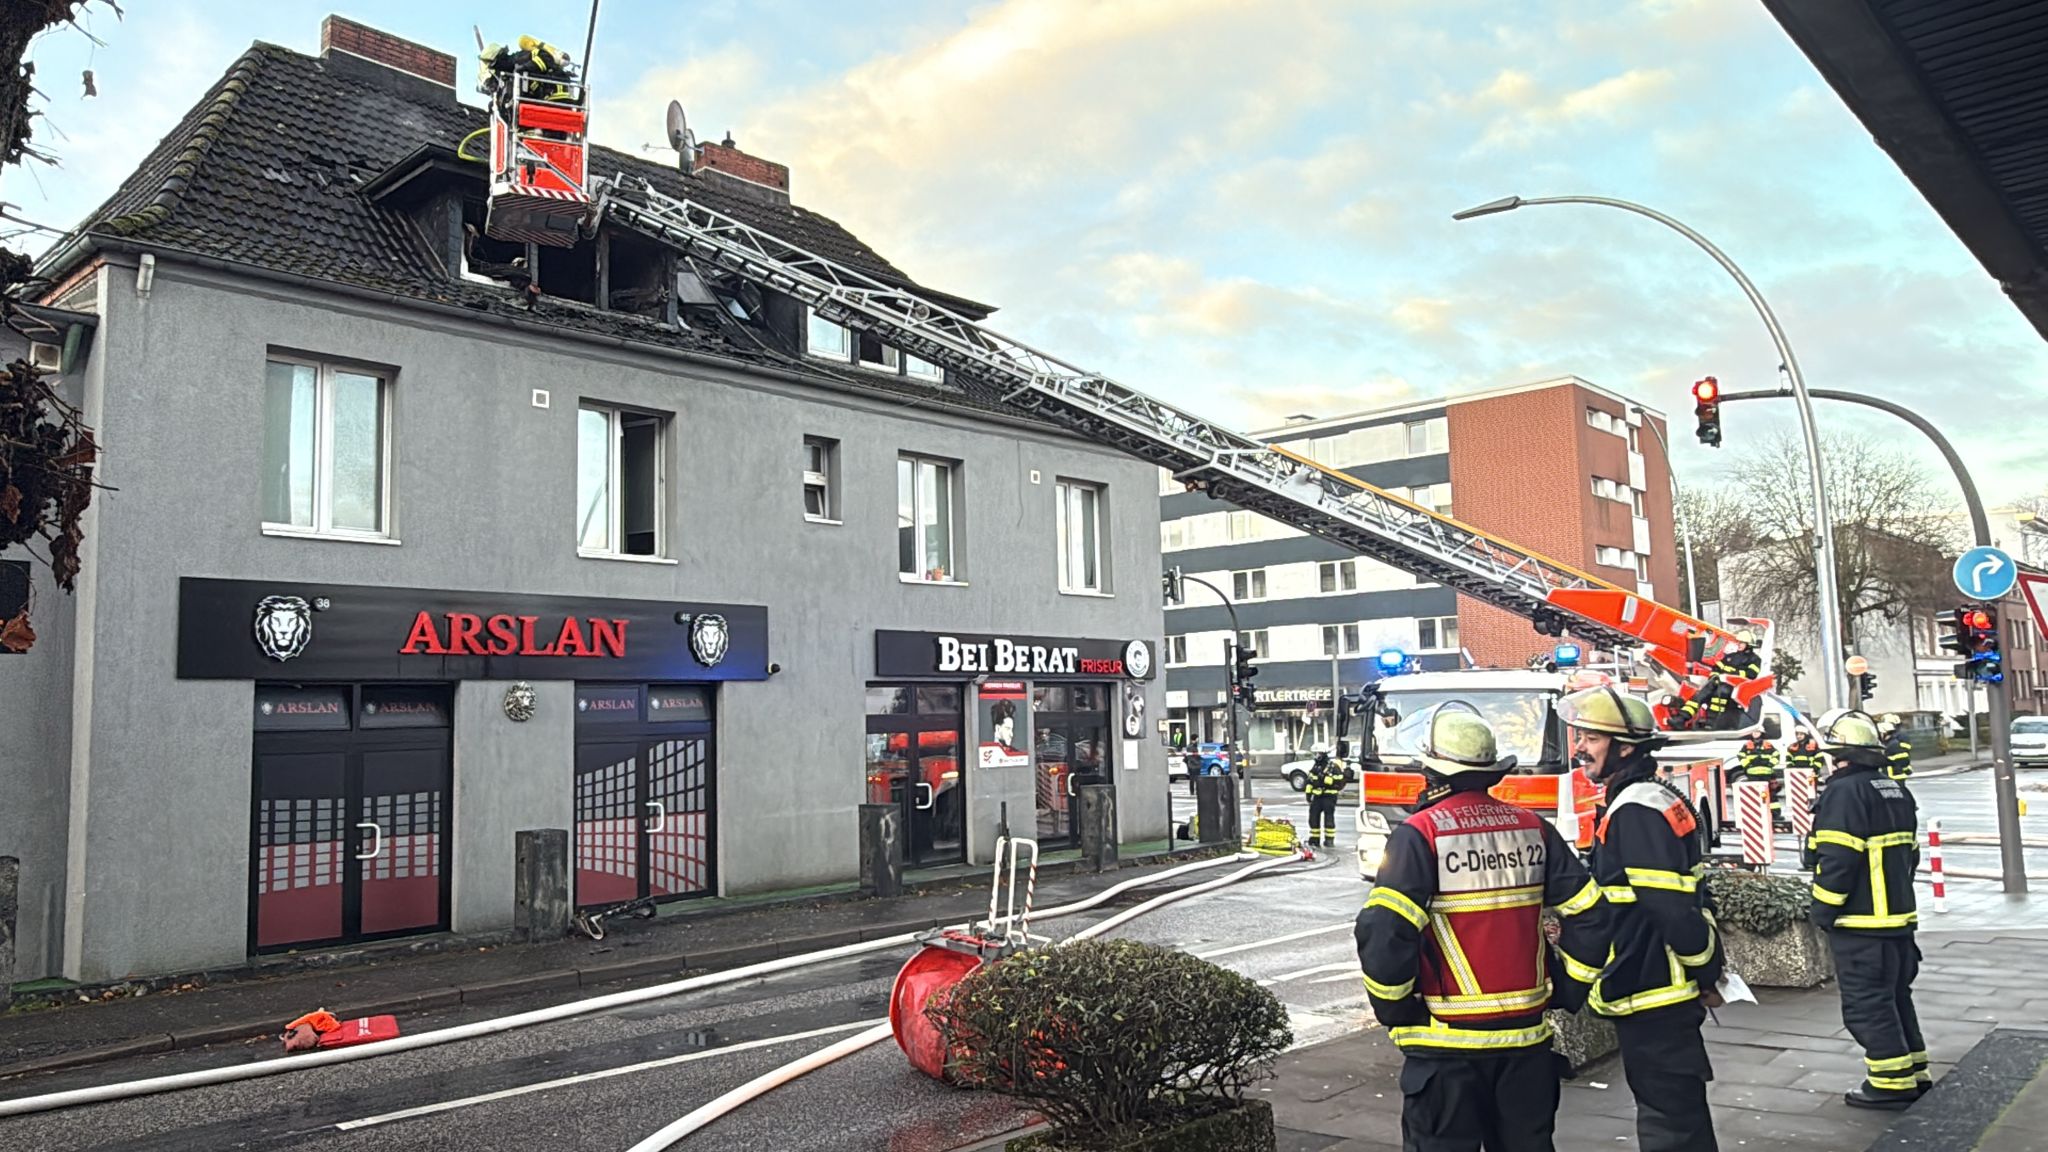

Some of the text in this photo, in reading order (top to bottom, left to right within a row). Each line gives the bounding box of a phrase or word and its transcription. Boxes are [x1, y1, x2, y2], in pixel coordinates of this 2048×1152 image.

[399, 610, 631, 658] ARSLAN
[938, 636, 1124, 674] BEI BERAT FRISEUR
[276, 702, 339, 714] ARSLAN
[380, 702, 437, 714] ARSLAN
[588, 699, 635, 711] ARSLAN
[661, 698, 703, 709] ARSLAN
[1459, 814, 1520, 830] HAMBURG
[1445, 844, 1544, 874] C-Dienst 22
